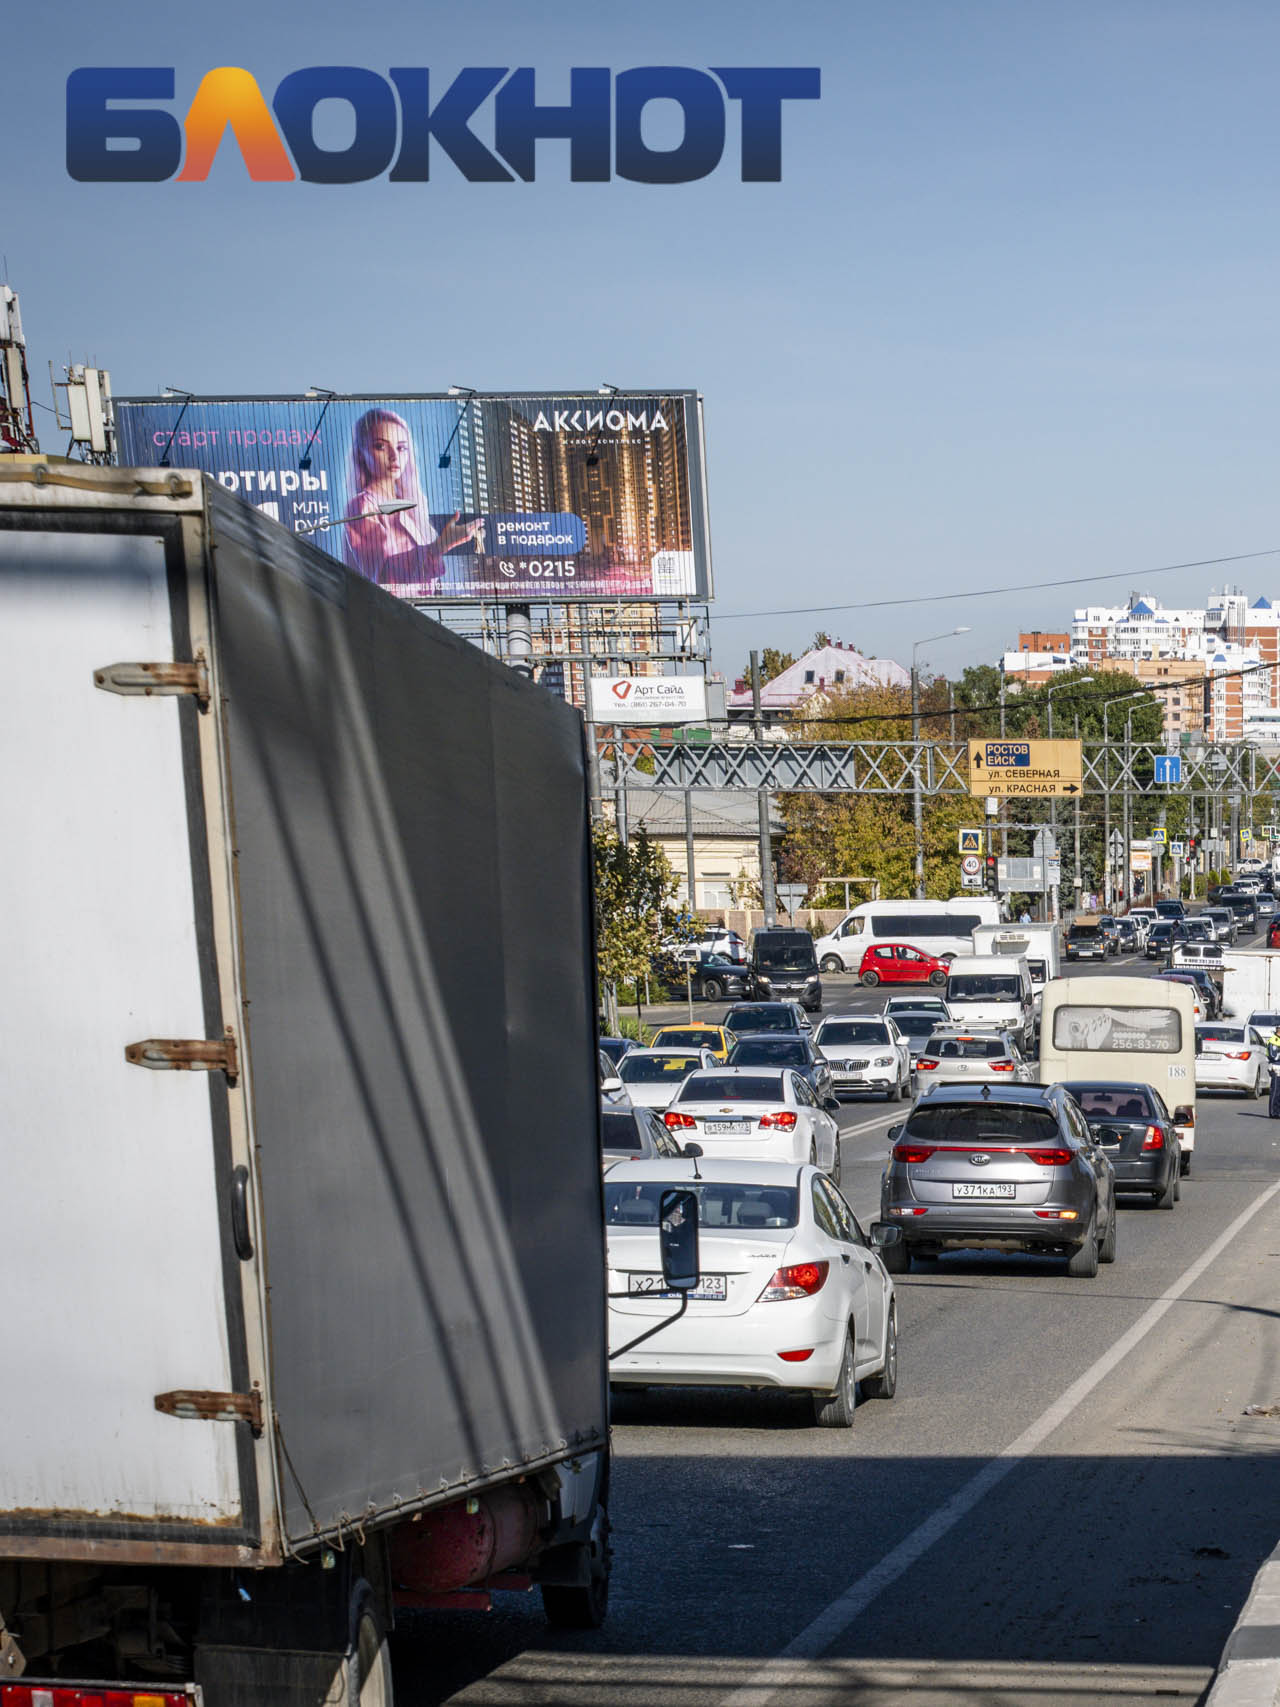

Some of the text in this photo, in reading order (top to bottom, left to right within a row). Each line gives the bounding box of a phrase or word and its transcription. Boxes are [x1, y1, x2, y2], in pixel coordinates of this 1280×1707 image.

[532, 410, 670, 432] АКСИОМА
[153, 428, 323, 449] старт продаж
[205, 470, 328, 496] ртиры
[293, 501, 330, 514] млн
[294, 515, 331, 535] руб
[497, 521, 550, 532] ремонт
[498, 534, 574, 547] в подарок
[634, 684, 685, 696] Арт Сайд
[986, 745, 1029, 755] РОСТОВ
[987, 754, 1017, 765] ЕЙСК
[988, 769, 1060, 779] ул. СЕВЕРНАЯ
[988, 784, 1056, 795] ул. КРАСНАЯ
[1112, 1039, 1169, 1049] 256-83-70
[1169, 1066, 1187, 1077] 188
[997, 1184, 1012, 1193] 193
[700, 1277, 722, 1289] 123
